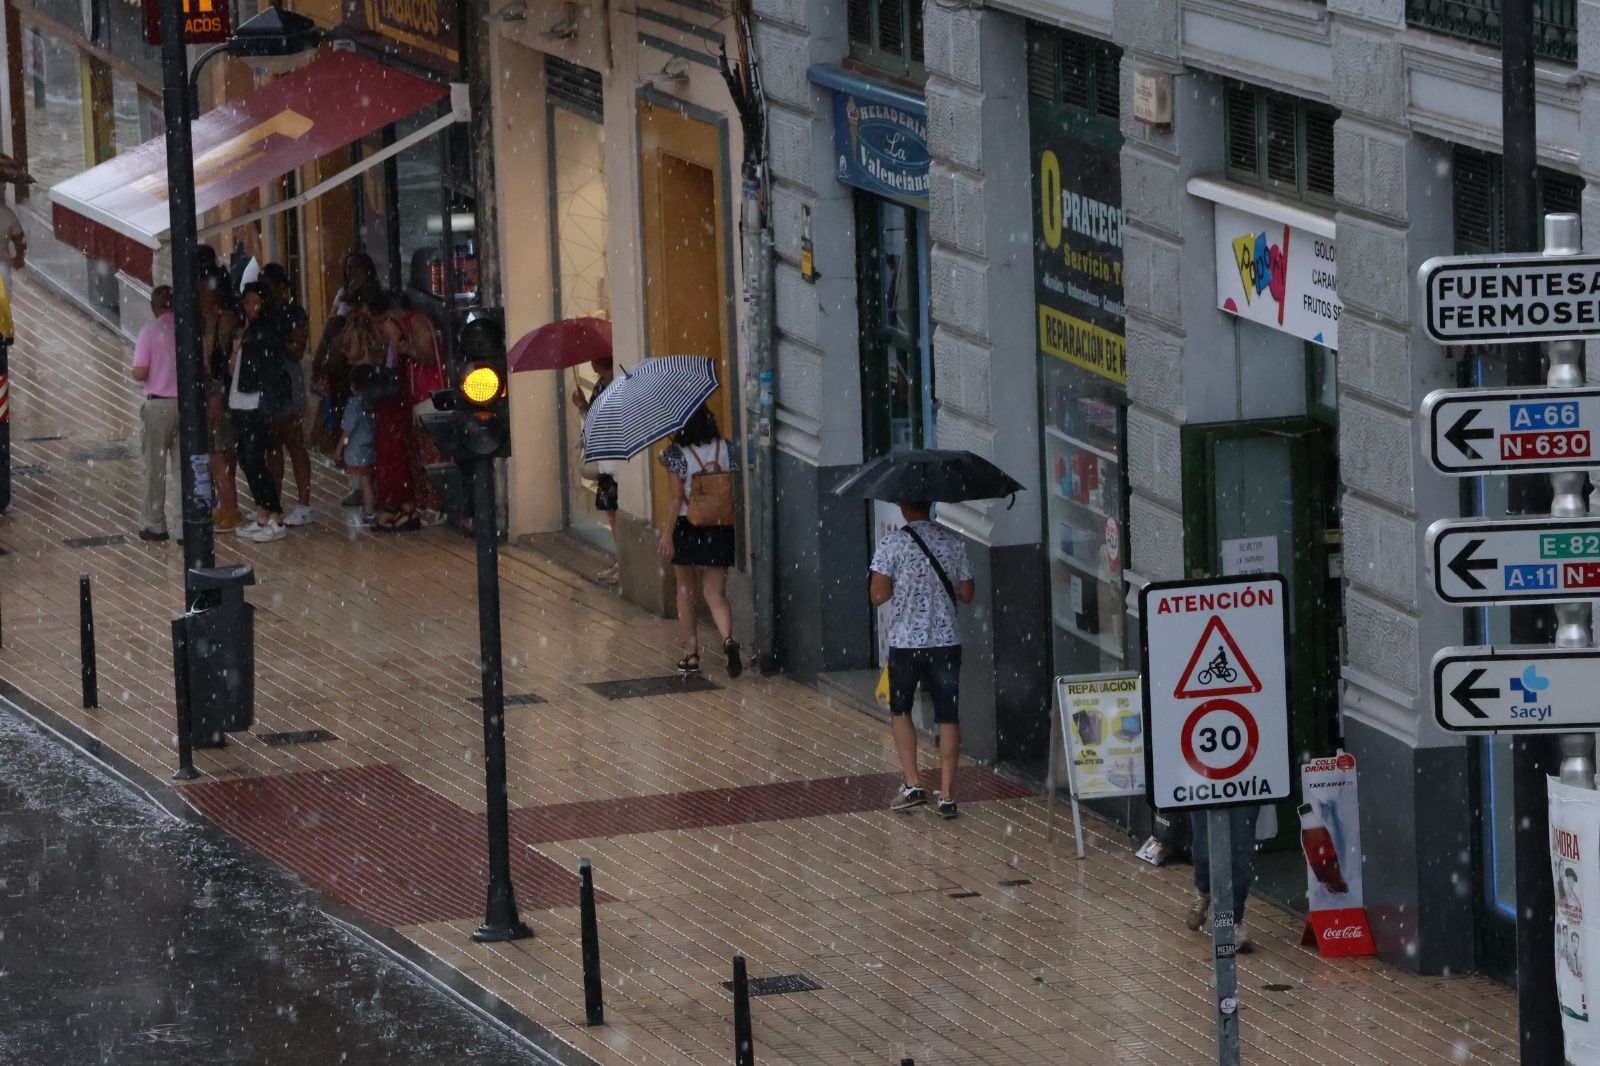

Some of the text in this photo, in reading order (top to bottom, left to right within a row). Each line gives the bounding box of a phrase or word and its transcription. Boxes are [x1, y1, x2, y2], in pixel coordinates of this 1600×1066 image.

[184, 17, 221, 33] ACOS
[860, 143, 930, 191] Valenciana
[1064, 243, 1110, 283] Servicio
[1314, 240, 1337, 264] GOLO
[1303, 294, 1332, 318] FRUTOS
[1439, 301, 1600, 329] FERMOSE
[1105, 338, 1118, 374] DE
[1513, 404, 1576, 428] A-66
[1503, 434, 1588, 457] N-630
[1543, 536, 1600, 556] E-82
[1508, 565, 1600, 587] A-11 N-
[1157, 586, 1274, 615] ATENCIÓN
[1510, 704, 1552, 721] Sacyl
[1198, 725, 1242, 753] 30
[1304, 764, 1336, 773] DRINKS
[1315, 758, 1336, 766] COLD
[1173, 776, 1272, 802] CICLOVÍA
[1552, 826, 1580, 861] AMORA
